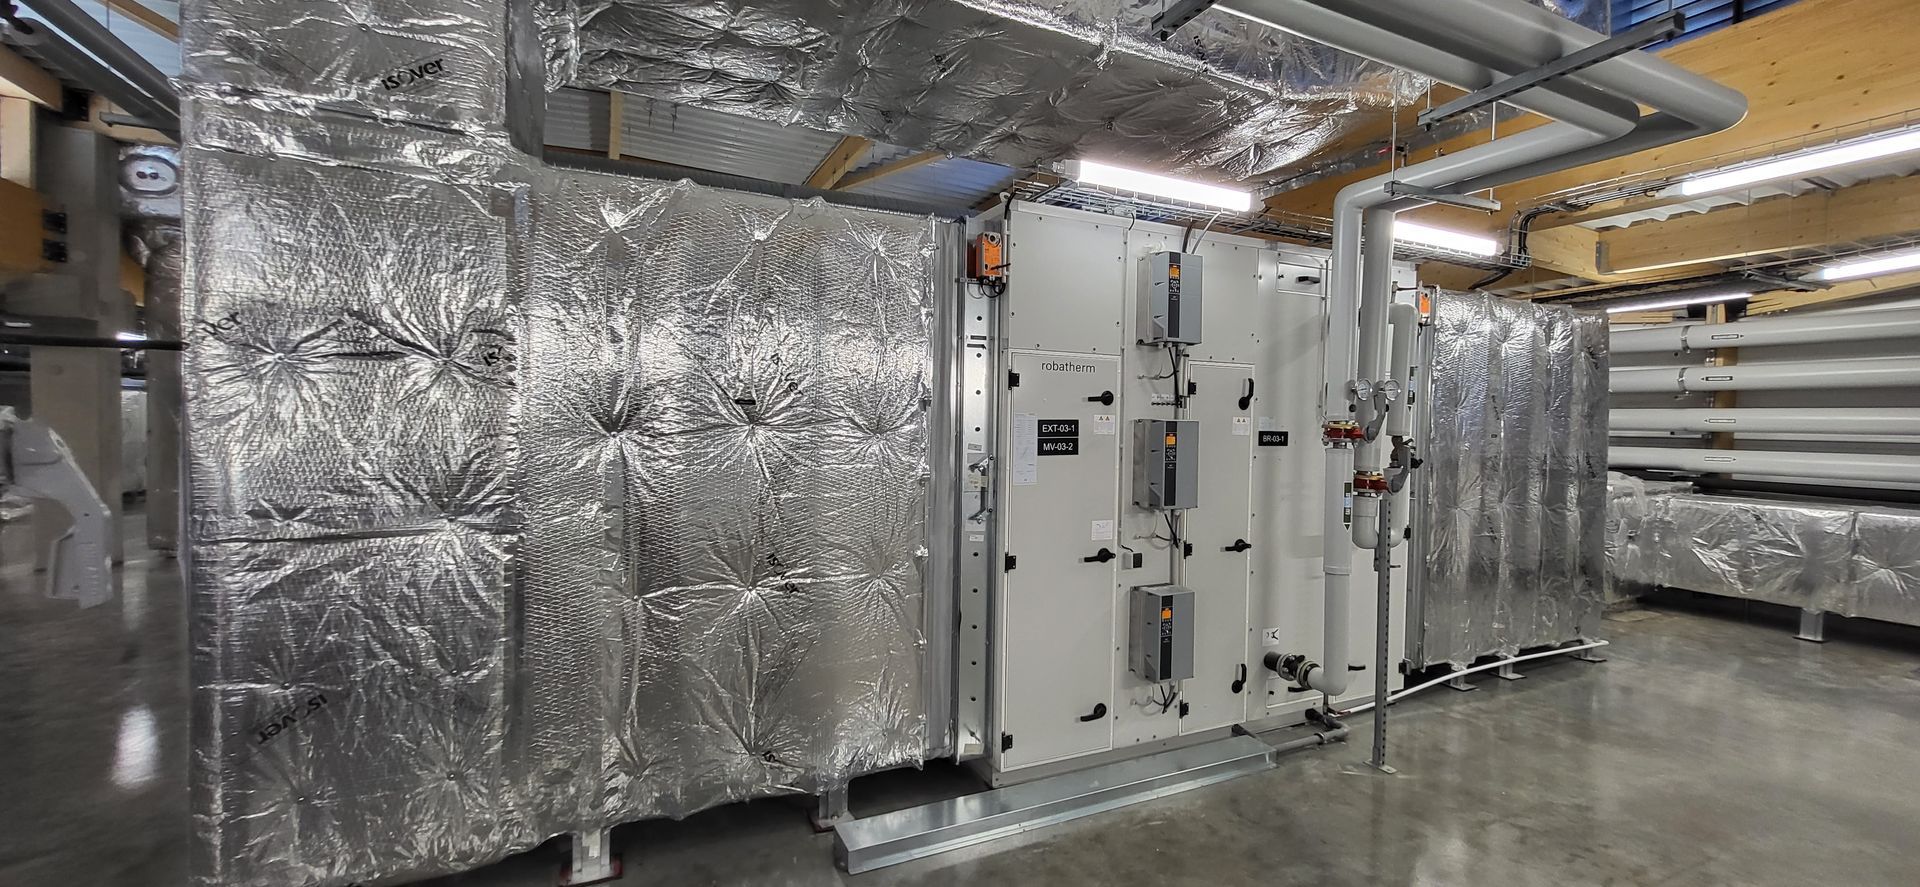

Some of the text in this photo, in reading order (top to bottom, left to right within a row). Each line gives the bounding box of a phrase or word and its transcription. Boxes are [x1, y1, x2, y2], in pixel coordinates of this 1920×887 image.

[1041, 361, 1096, 373] robatherm
[1042, 424, 1075, 433] EXT-03-1
[1262, 434, 1285, 443] BR-03-1
[1043, 443, 1073, 451] MV-03-2
